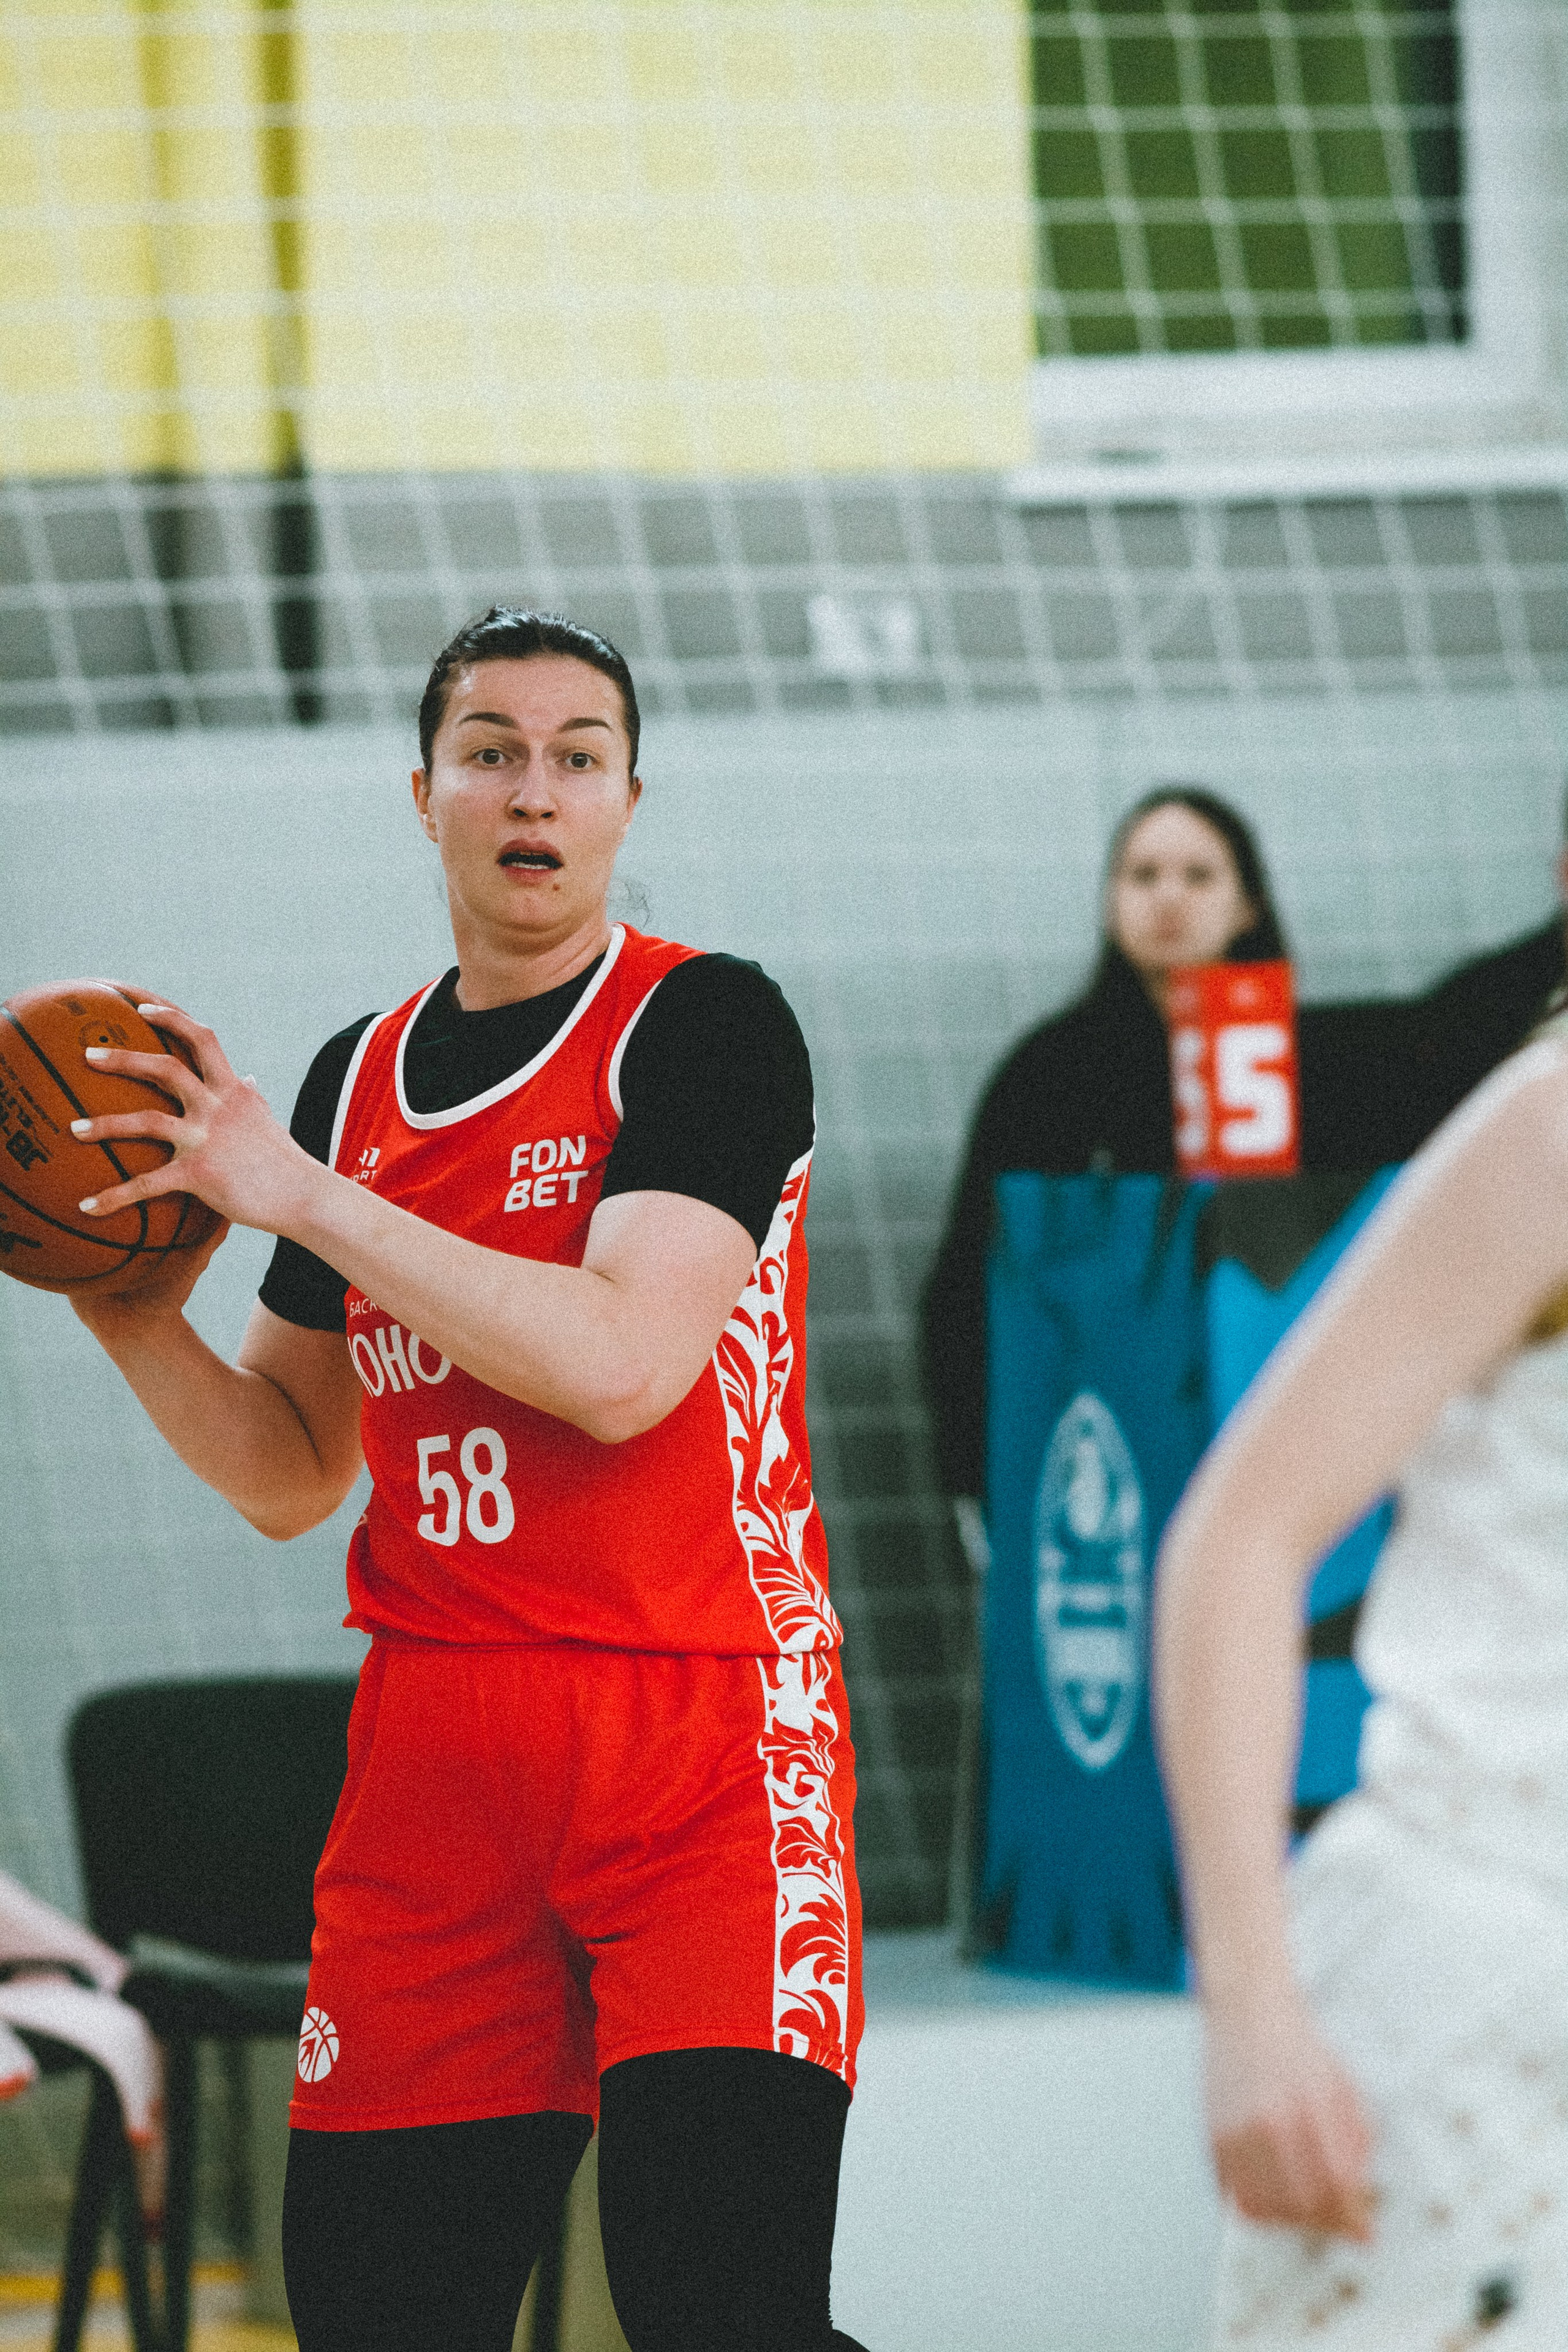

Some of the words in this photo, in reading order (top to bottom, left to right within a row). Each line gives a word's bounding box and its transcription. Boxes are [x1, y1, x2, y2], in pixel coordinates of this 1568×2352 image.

[1216, 1023, 1289, 1155] 5
[504, 1170, 589, 1213] BET
[510, 1135, 586, 1178] FON
[417, 1427, 515, 1547] 58
